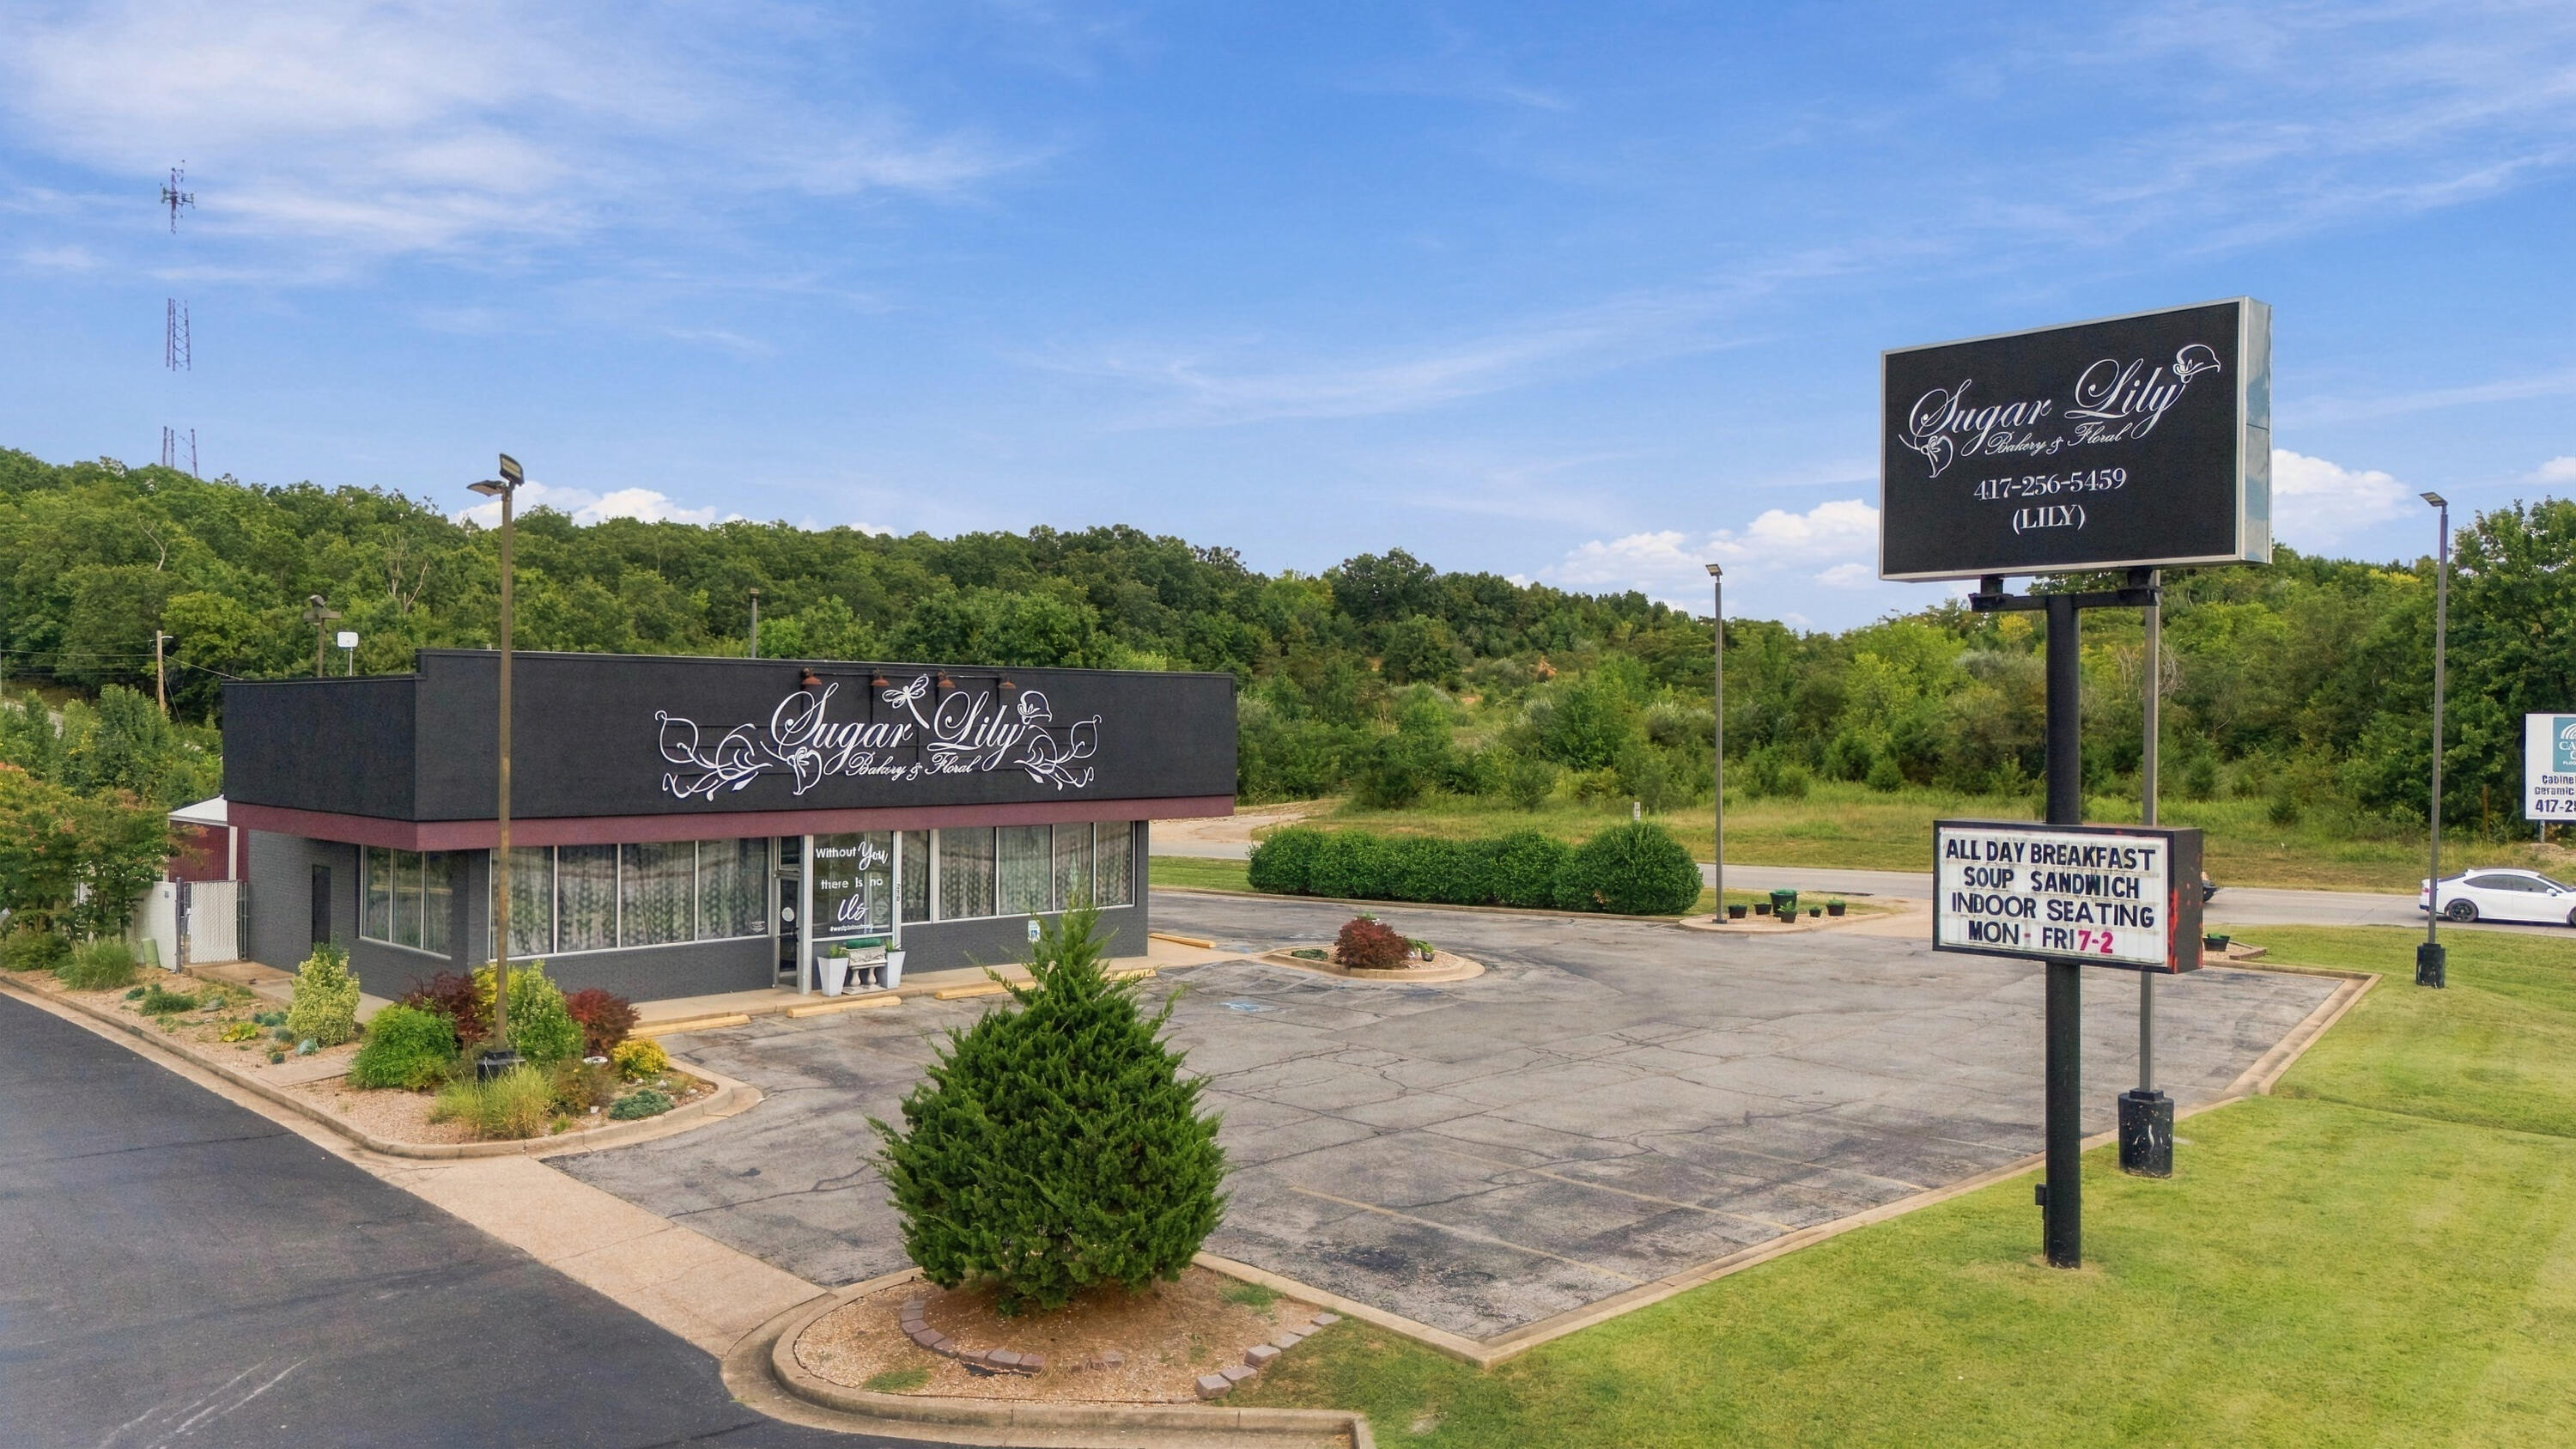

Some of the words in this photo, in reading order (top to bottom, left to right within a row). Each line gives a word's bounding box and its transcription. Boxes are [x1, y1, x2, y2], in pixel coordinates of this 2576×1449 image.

[1909, 378, 2051, 457] Sugar
[2065, 358, 2182, 440] Lily
[1984, 431, 2047, 457] Bakery
[2047, 436, 2063, 454] &
[2067, 422, 2131, 447] Floral
[1974, 468, 2127, 501] 417-256-5459
[2012, 504, 2086, 535] (LILY)
[771, 682, 914, 776] Sugar
[927, 691, 1024, 770] Lily
[846, 752, 907, 780] Bakery
[907, 762, 923, 780] &
[925, 752, 981, 775] Floral
[2542, 775, 2576, 784] Cabine
[2535, 786, 2574, 795] Ceramic
[816, 846, 857, 859] Without
[858, 841, 889, 871] You
[1946, 838, 1981, 861] ALL
[1987, 841, 2026, 863] DAY
[2031, 843, 2156, 871] BREAKFAST
[821, 879, 848, 890] there
[854, 877, 863, 888] is
[869, 877, 884, 887] no
[1964, 866, 2014, 889] SOUP
[2031, 871, 2139, 899] SANDWICH
[837, 893, 869, 922] Us
[1952, 892, 2036, 919] INDOOR
[2047, 898, 2154, 928] SEATING
[1968, 920, 2019, 945] MON
[2042, 927, 2075, 950] FRI
[2078, 929, 2113, 954] 7-2
